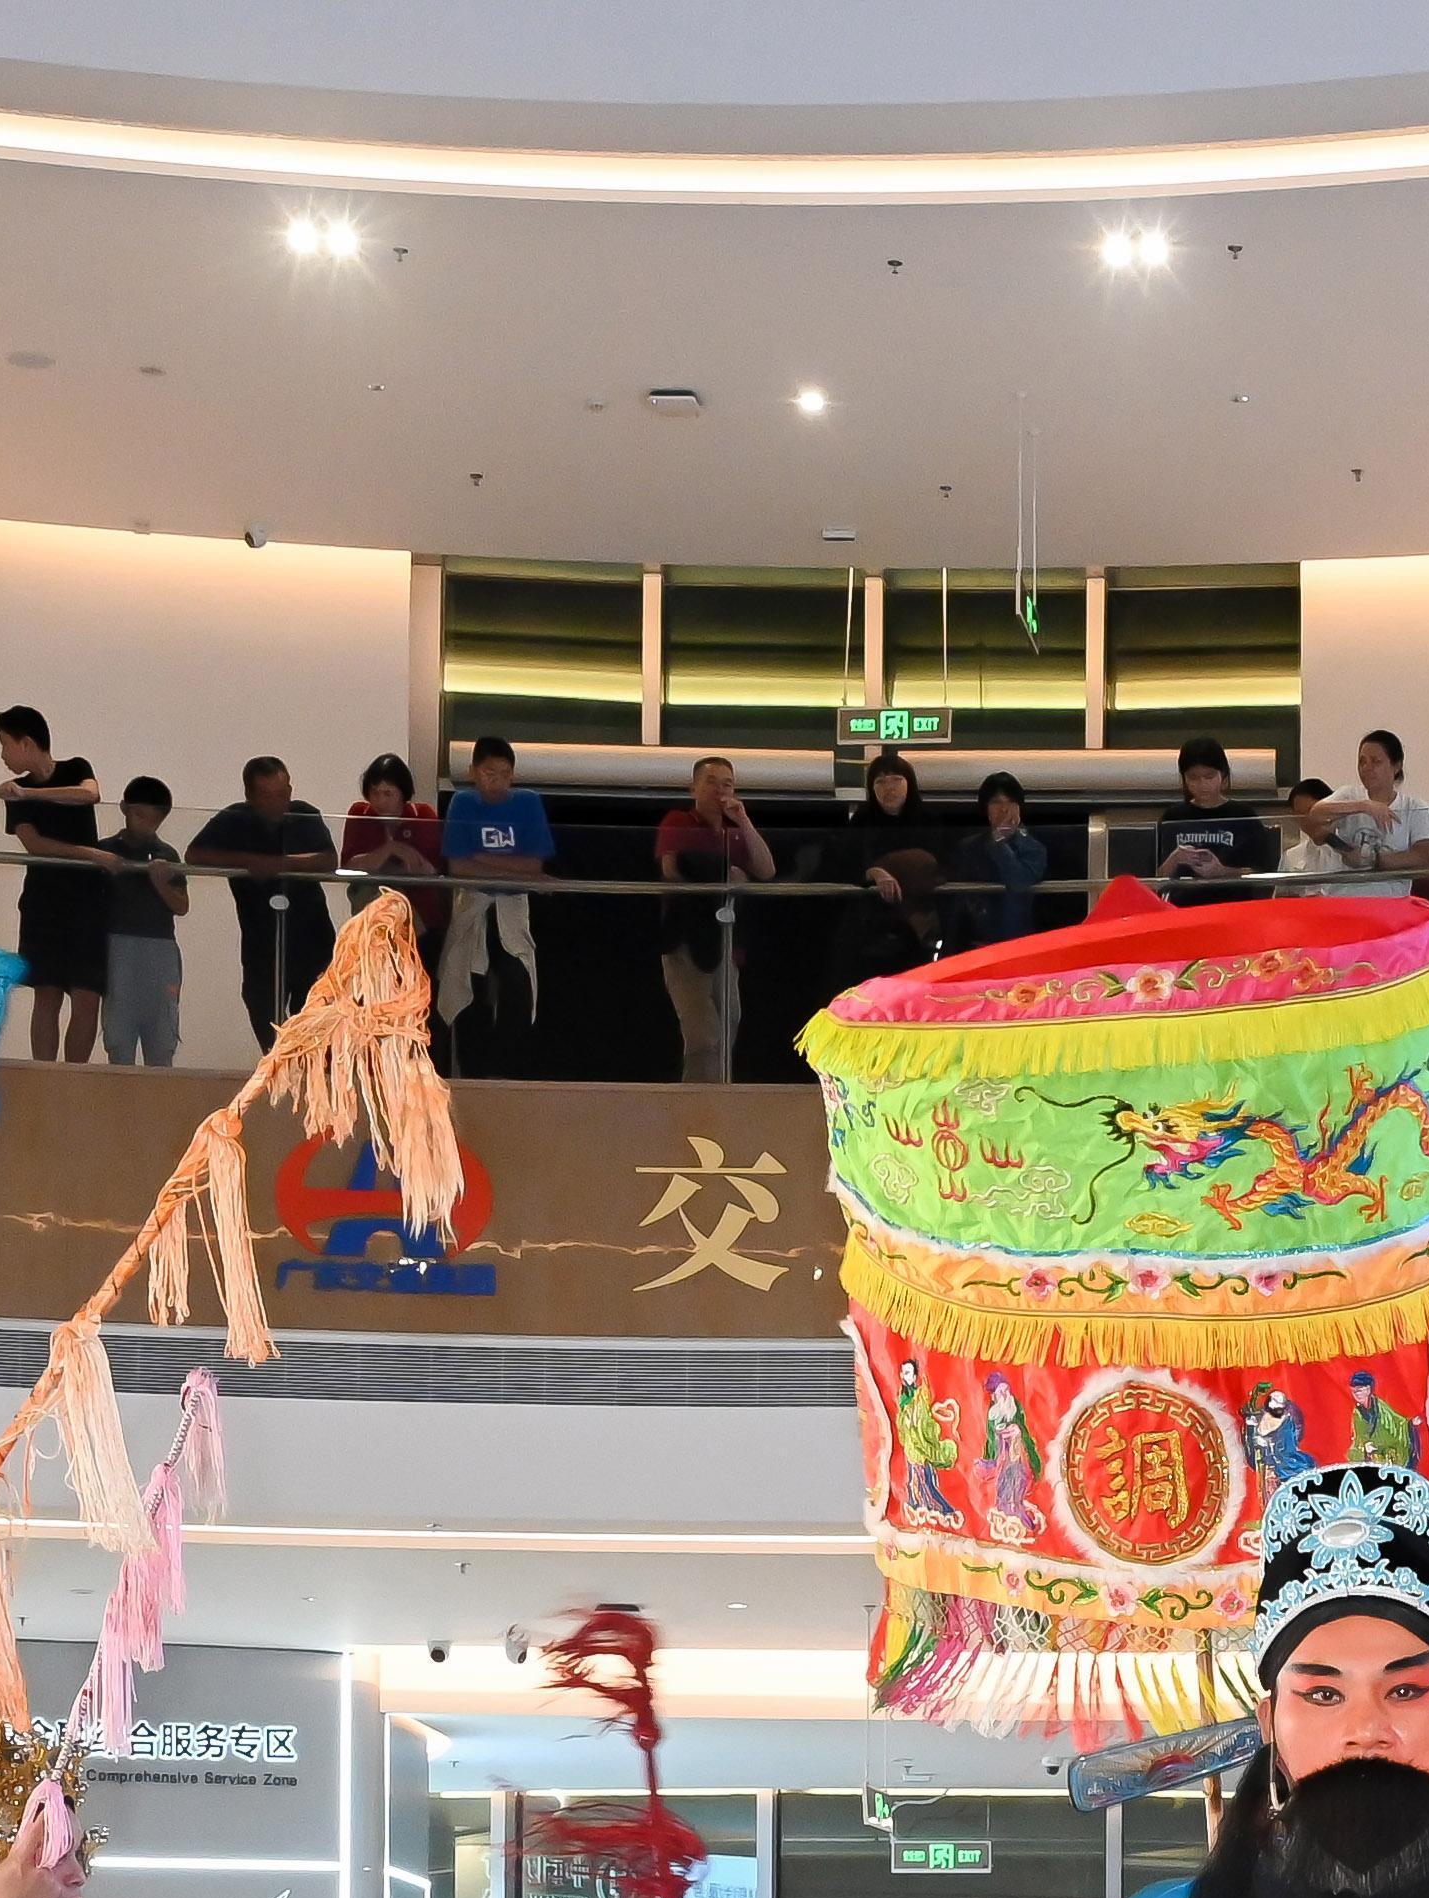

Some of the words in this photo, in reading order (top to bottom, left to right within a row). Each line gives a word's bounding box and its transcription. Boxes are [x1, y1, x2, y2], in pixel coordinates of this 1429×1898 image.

[1094, 1427, 1189, 1529] 調
[86, 1769, 198, 1784] Comprehensive
[204, 1771, 257, 1785] Service
[263, 1774, 298, 1787] Zone
